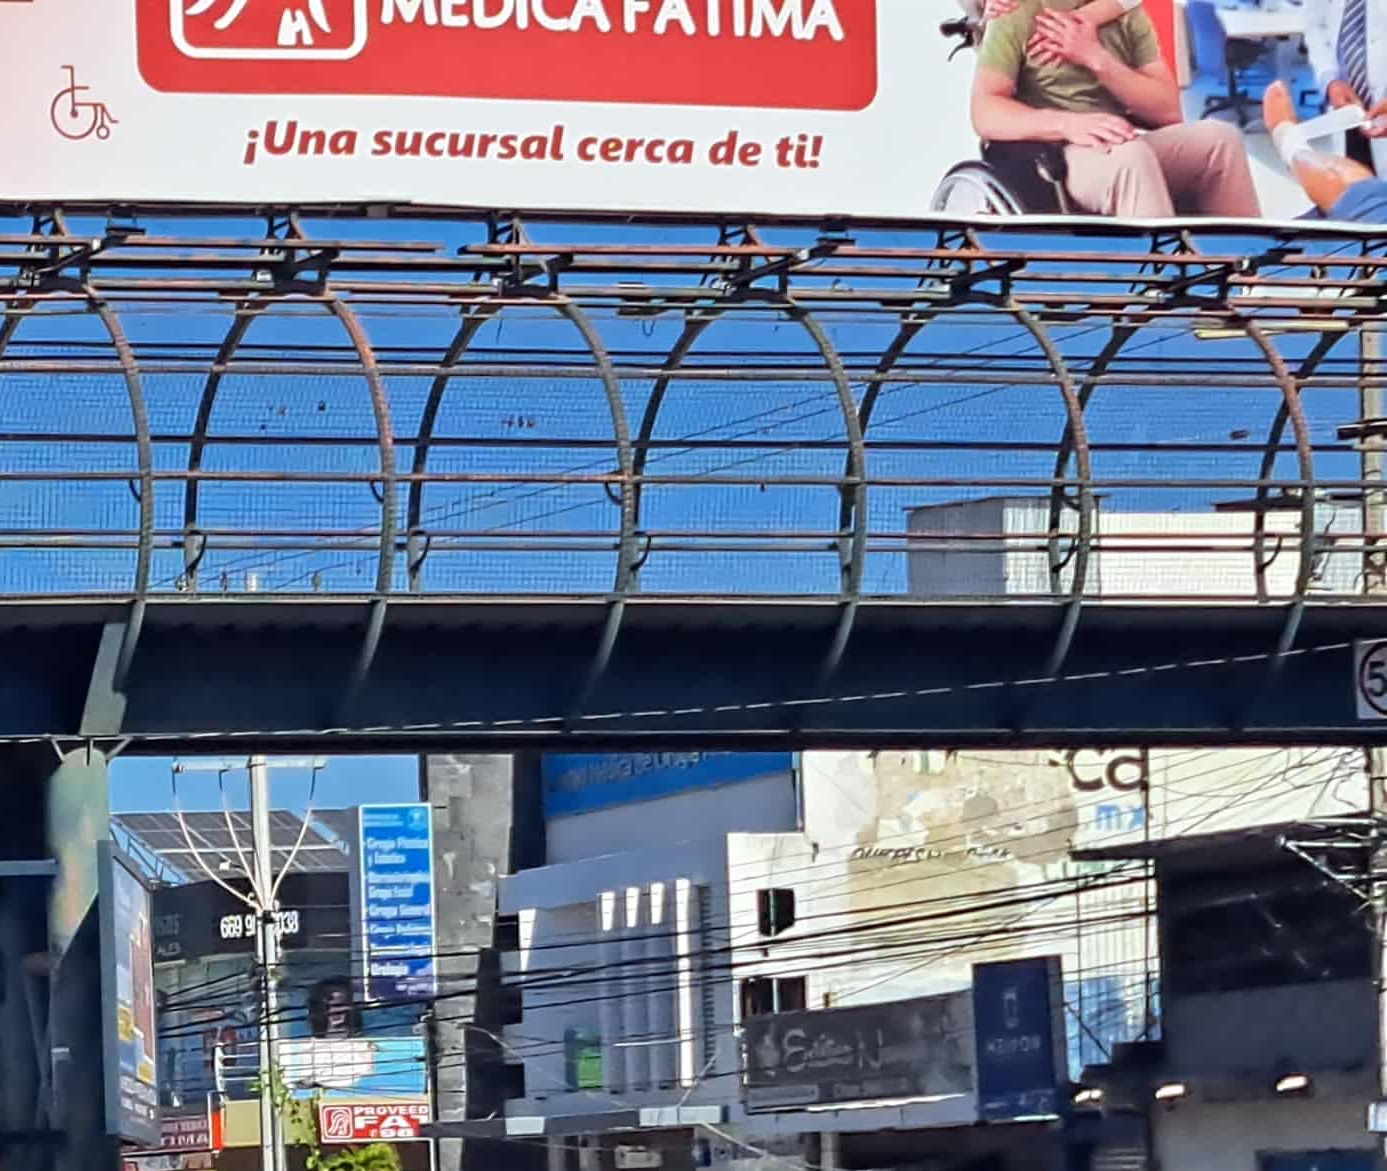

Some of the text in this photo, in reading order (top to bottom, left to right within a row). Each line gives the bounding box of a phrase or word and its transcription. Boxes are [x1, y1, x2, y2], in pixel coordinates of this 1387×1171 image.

[243, 120, 824, 169] ¡Una sucursal cerca de ti!
